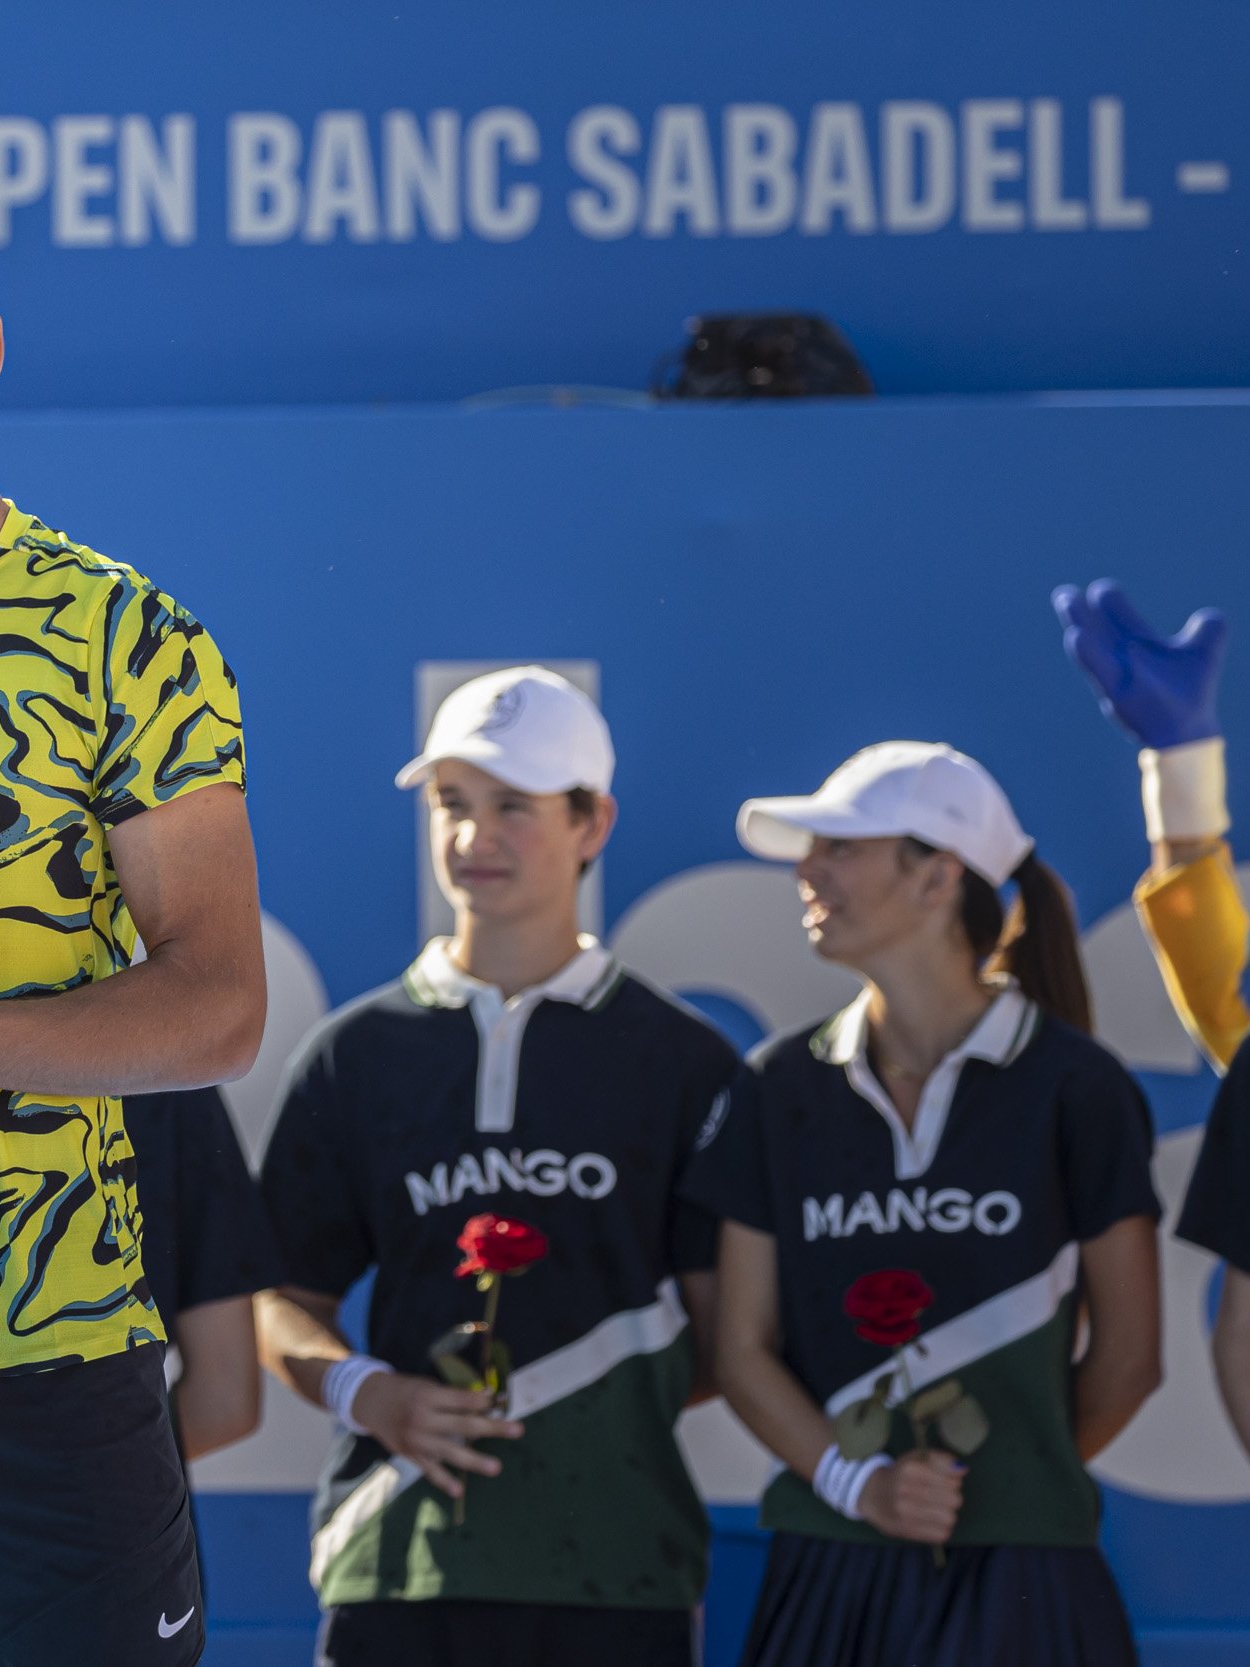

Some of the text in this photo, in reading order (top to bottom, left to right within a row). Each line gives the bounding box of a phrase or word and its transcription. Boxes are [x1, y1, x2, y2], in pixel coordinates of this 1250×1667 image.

[227, 106, 542, 245] BANC
[567, 96, 1150, 240] SABADELL
[404, 1146, 617, 1217] MANGO
[802, 1186, 1022, 1242] MANGO
